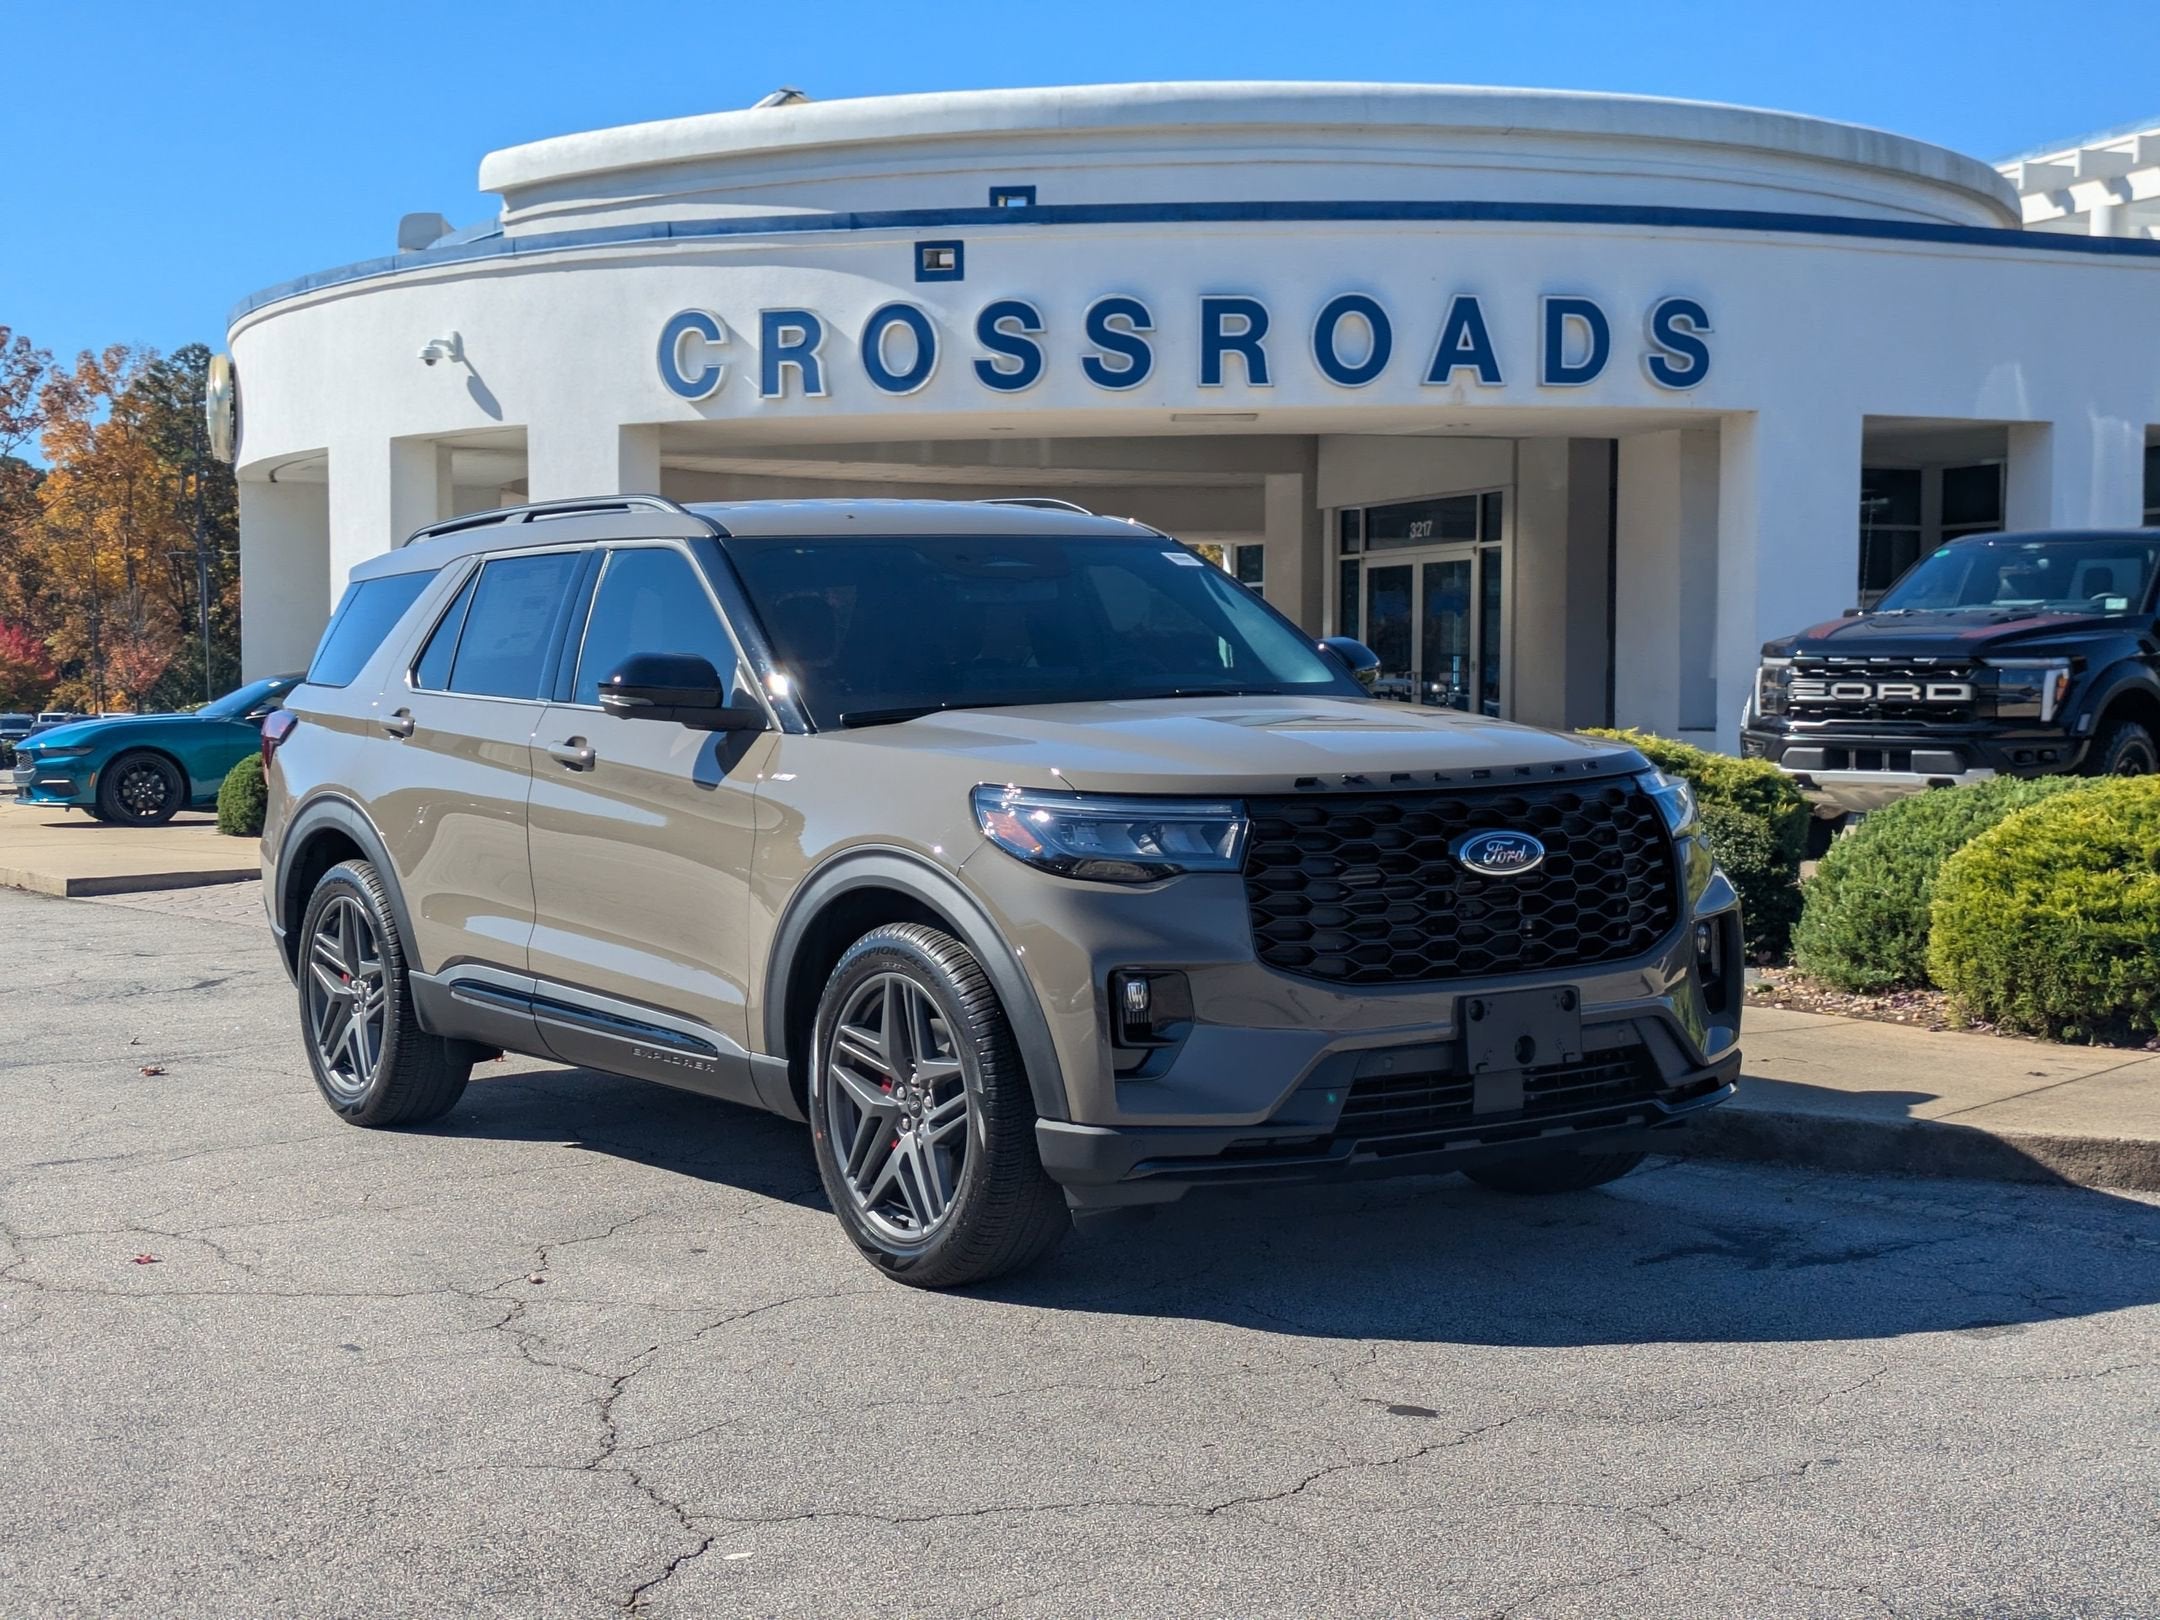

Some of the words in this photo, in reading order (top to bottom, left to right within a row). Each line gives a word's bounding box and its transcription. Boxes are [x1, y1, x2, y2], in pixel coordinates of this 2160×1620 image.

[657, 292, 1713, 401] CROSSROADS
[1409, 520, 1433, 539] 3217
[1787, 681, 1972, 701] FORD
[1483, 840, 1527, 865] Ford
[633, 1048, 715, 1073] EXPLORER
